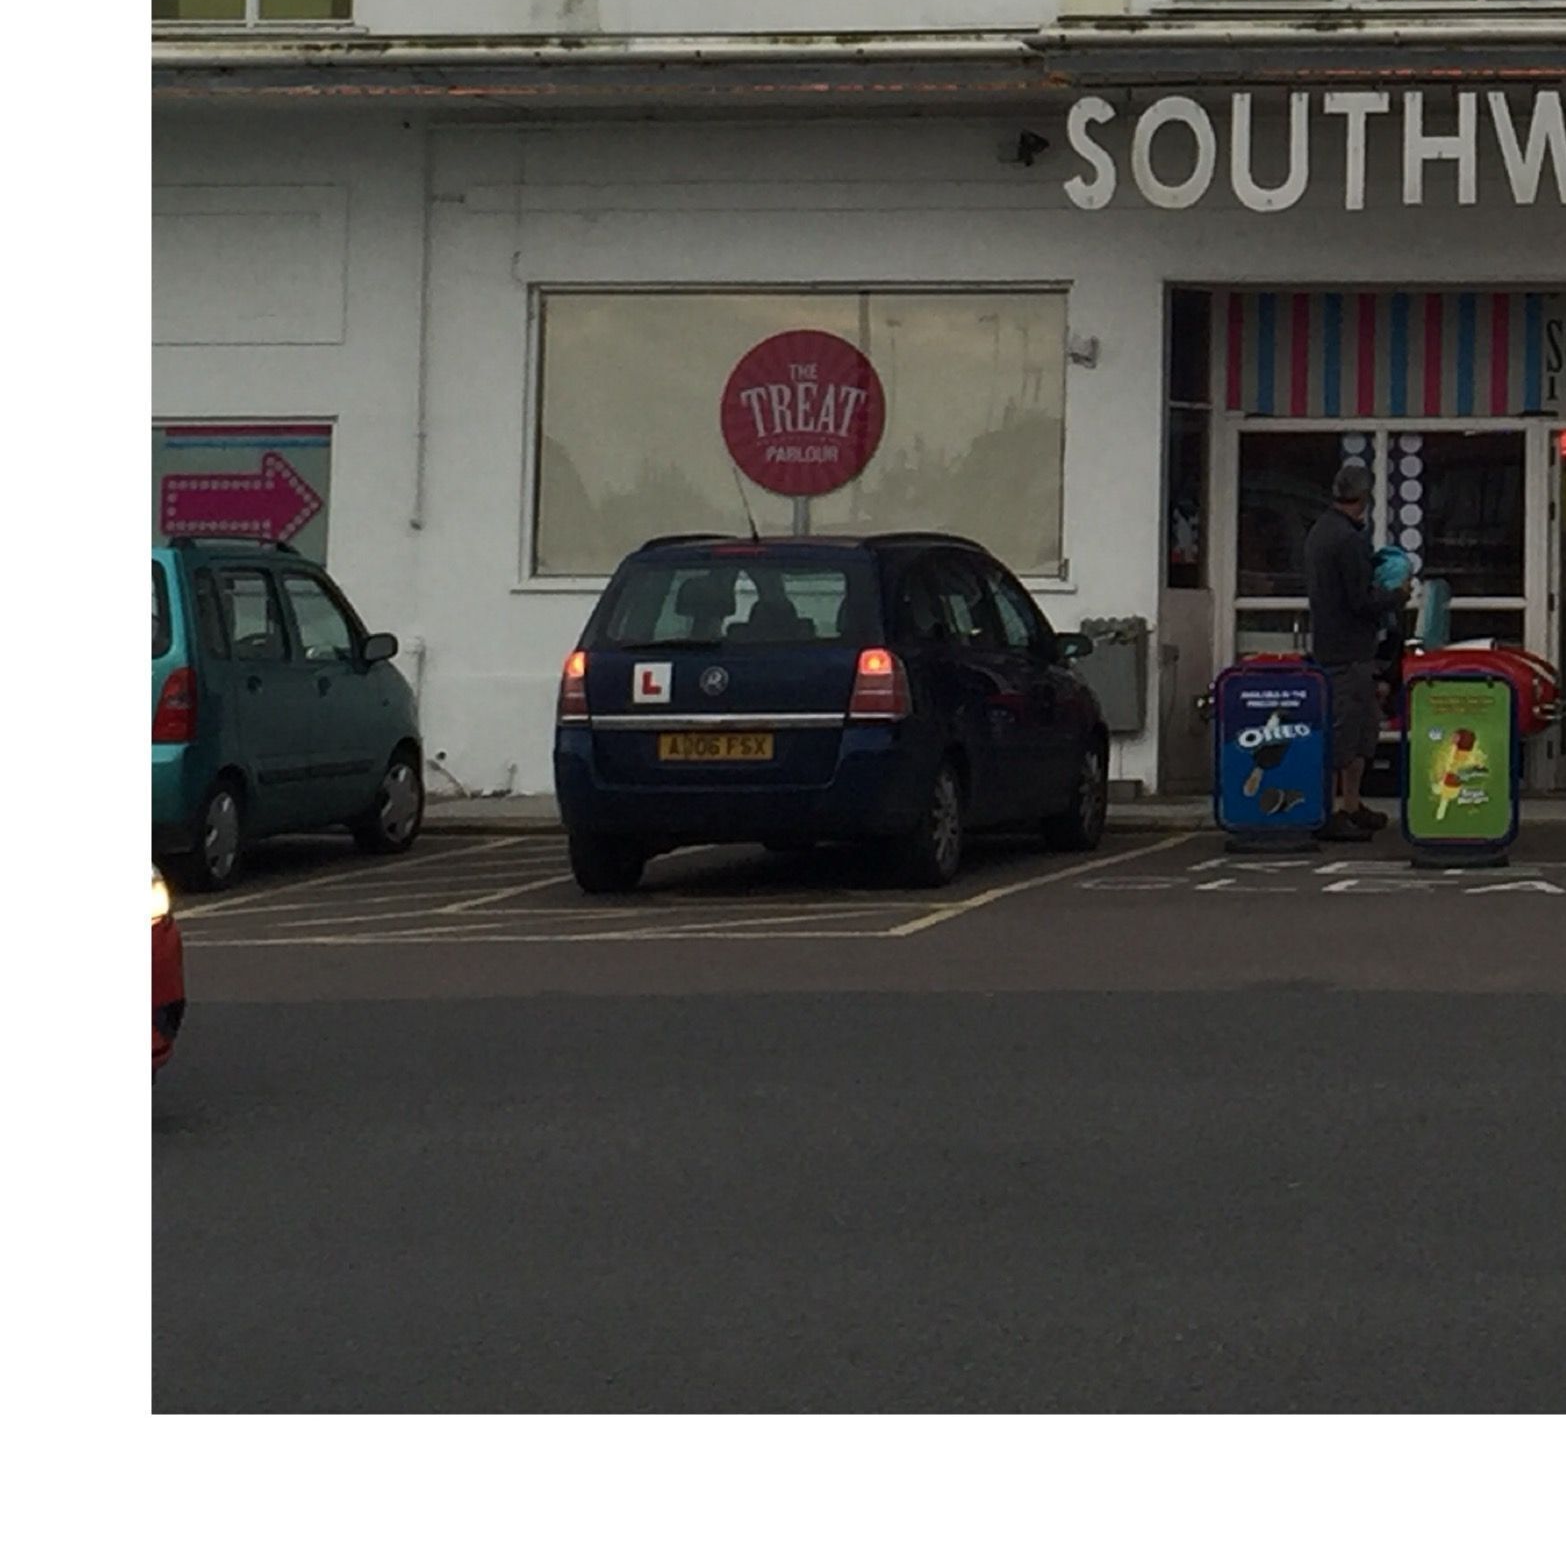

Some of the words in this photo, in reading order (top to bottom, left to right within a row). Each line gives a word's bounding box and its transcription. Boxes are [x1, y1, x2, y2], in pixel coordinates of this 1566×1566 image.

[789, 363, 817, 381] THE
[740, 382, 866, 437] TREAT
[765, 444, 839, 463] PARLOUR
[642, 670, 662, 695] L
[1239, 724, 1310, 747] OREO
